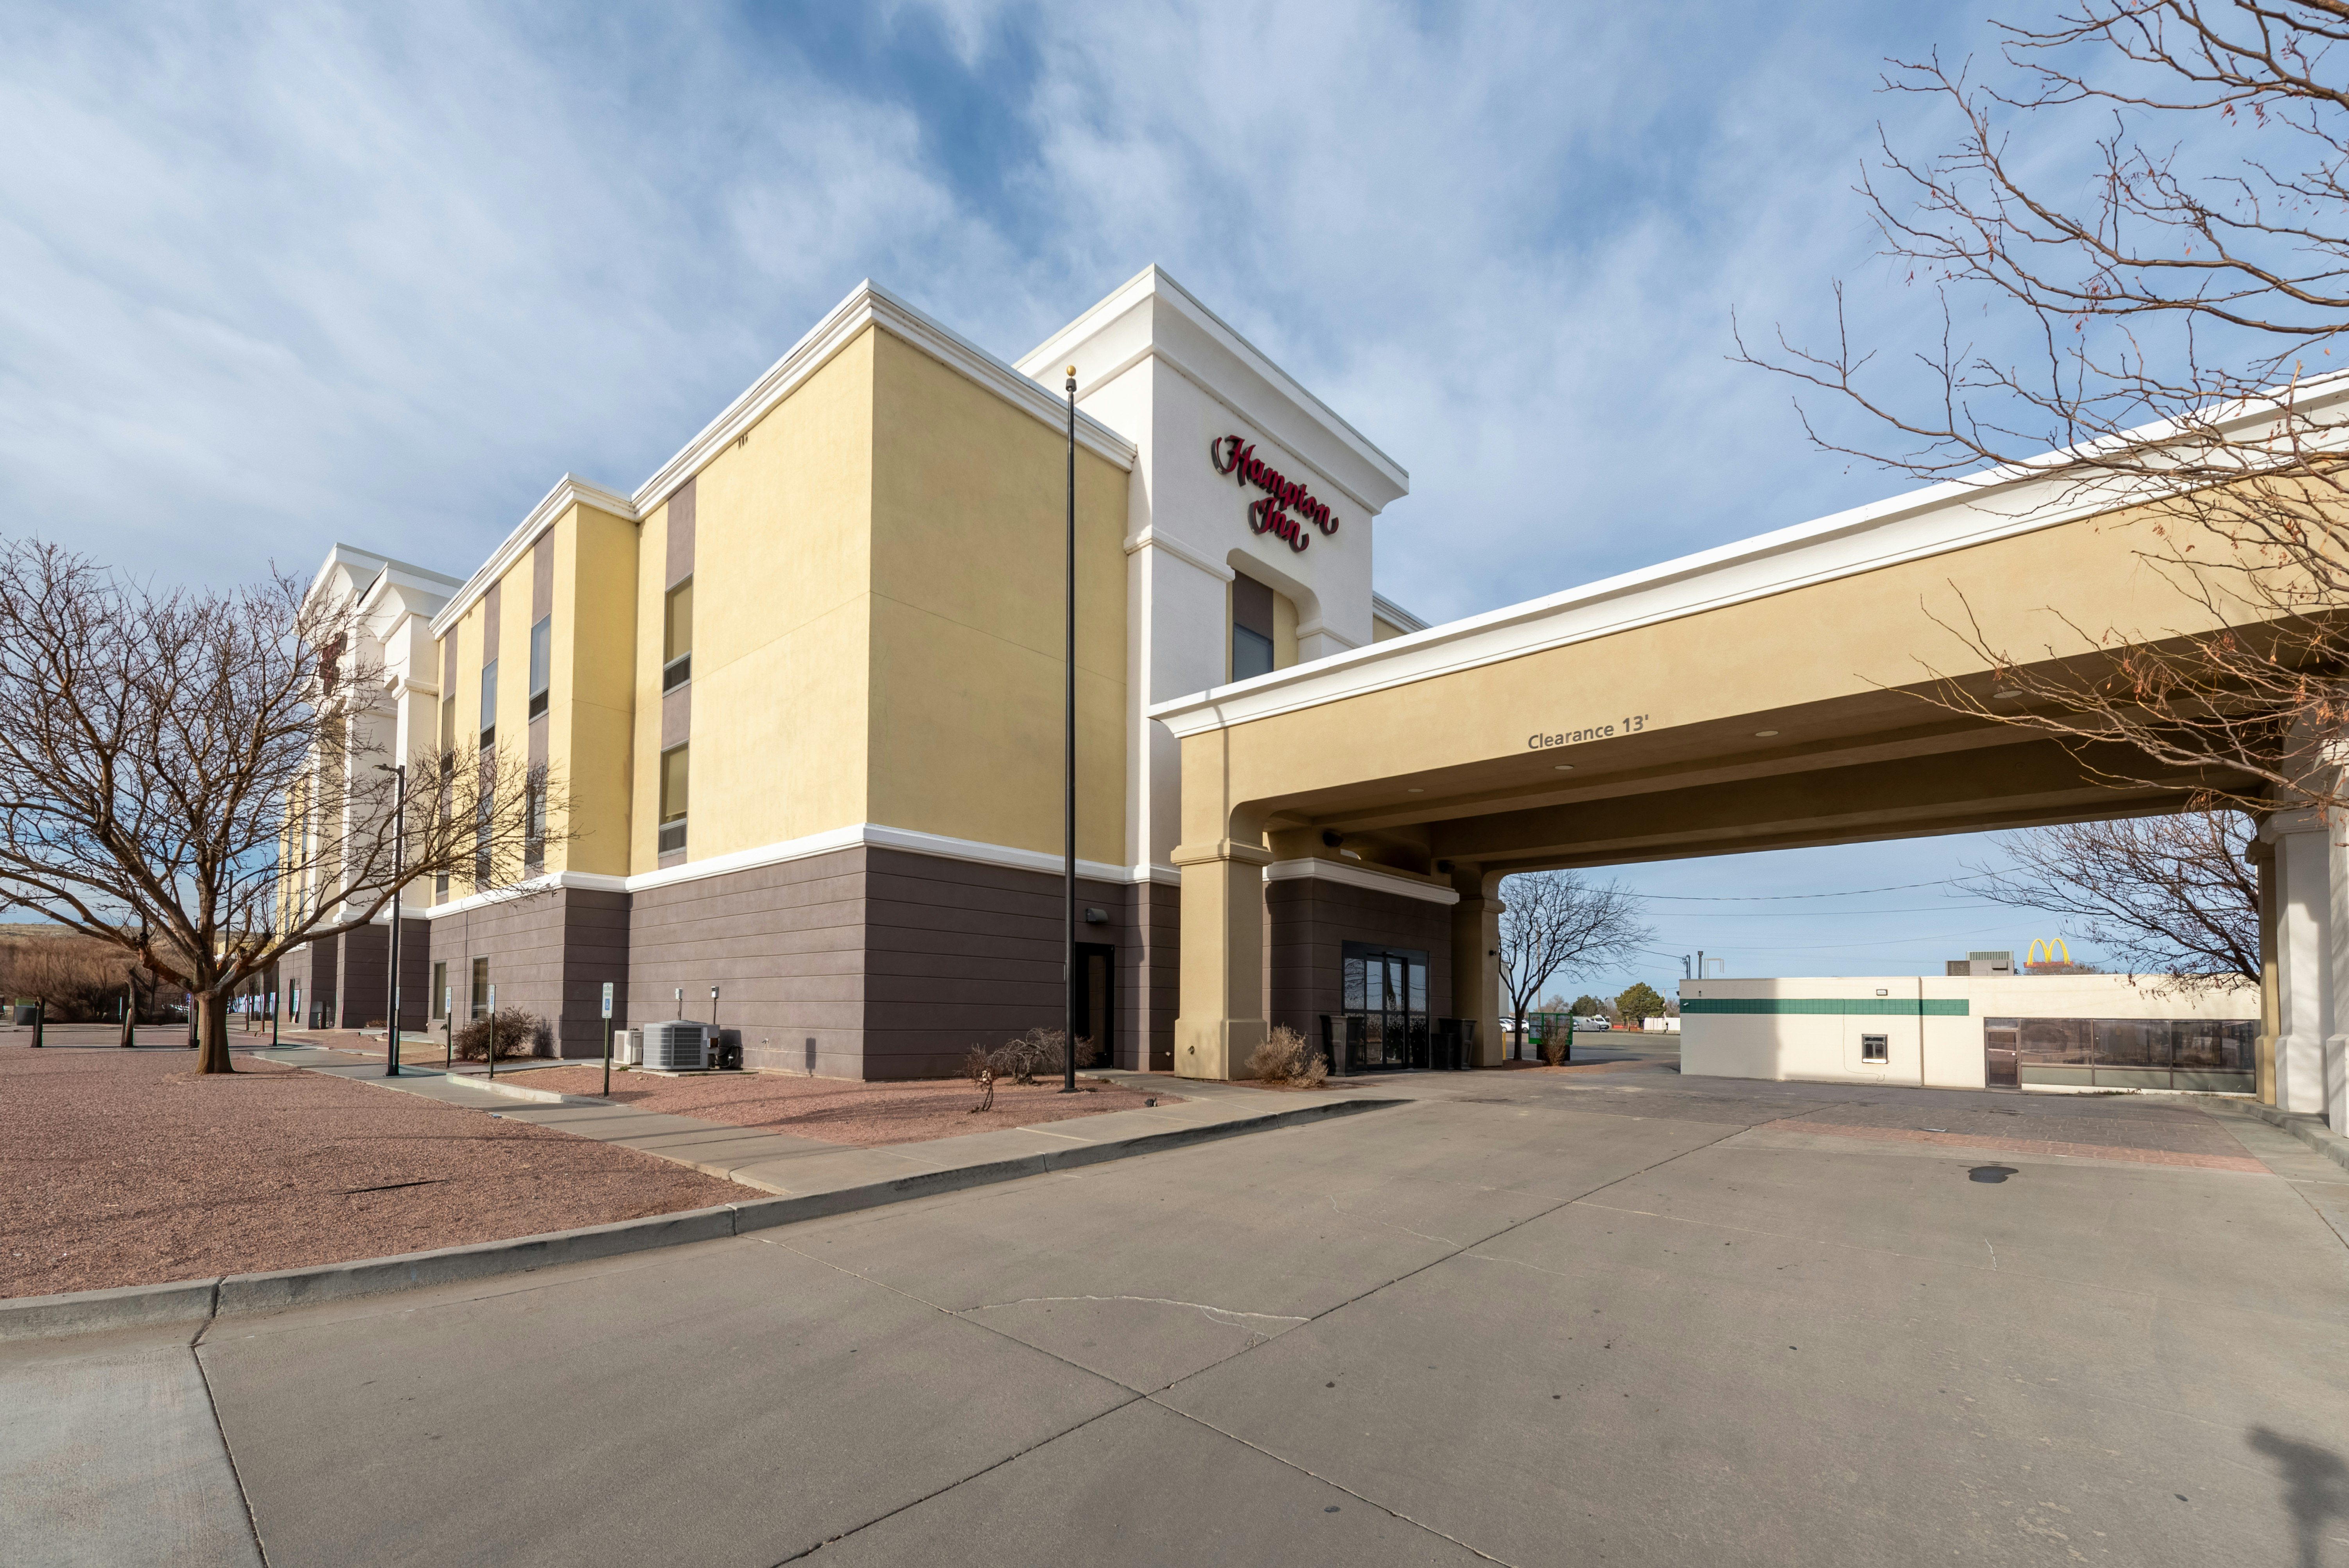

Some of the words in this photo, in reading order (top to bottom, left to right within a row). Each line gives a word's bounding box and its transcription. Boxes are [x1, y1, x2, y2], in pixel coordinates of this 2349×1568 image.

[1211, 435, 1339, 536] Hampton
[1247, 497, 1310, 553] Inn
[1528, 725, 1614, 749] Clearance
[1622, 714, 1649, 732] 13'
